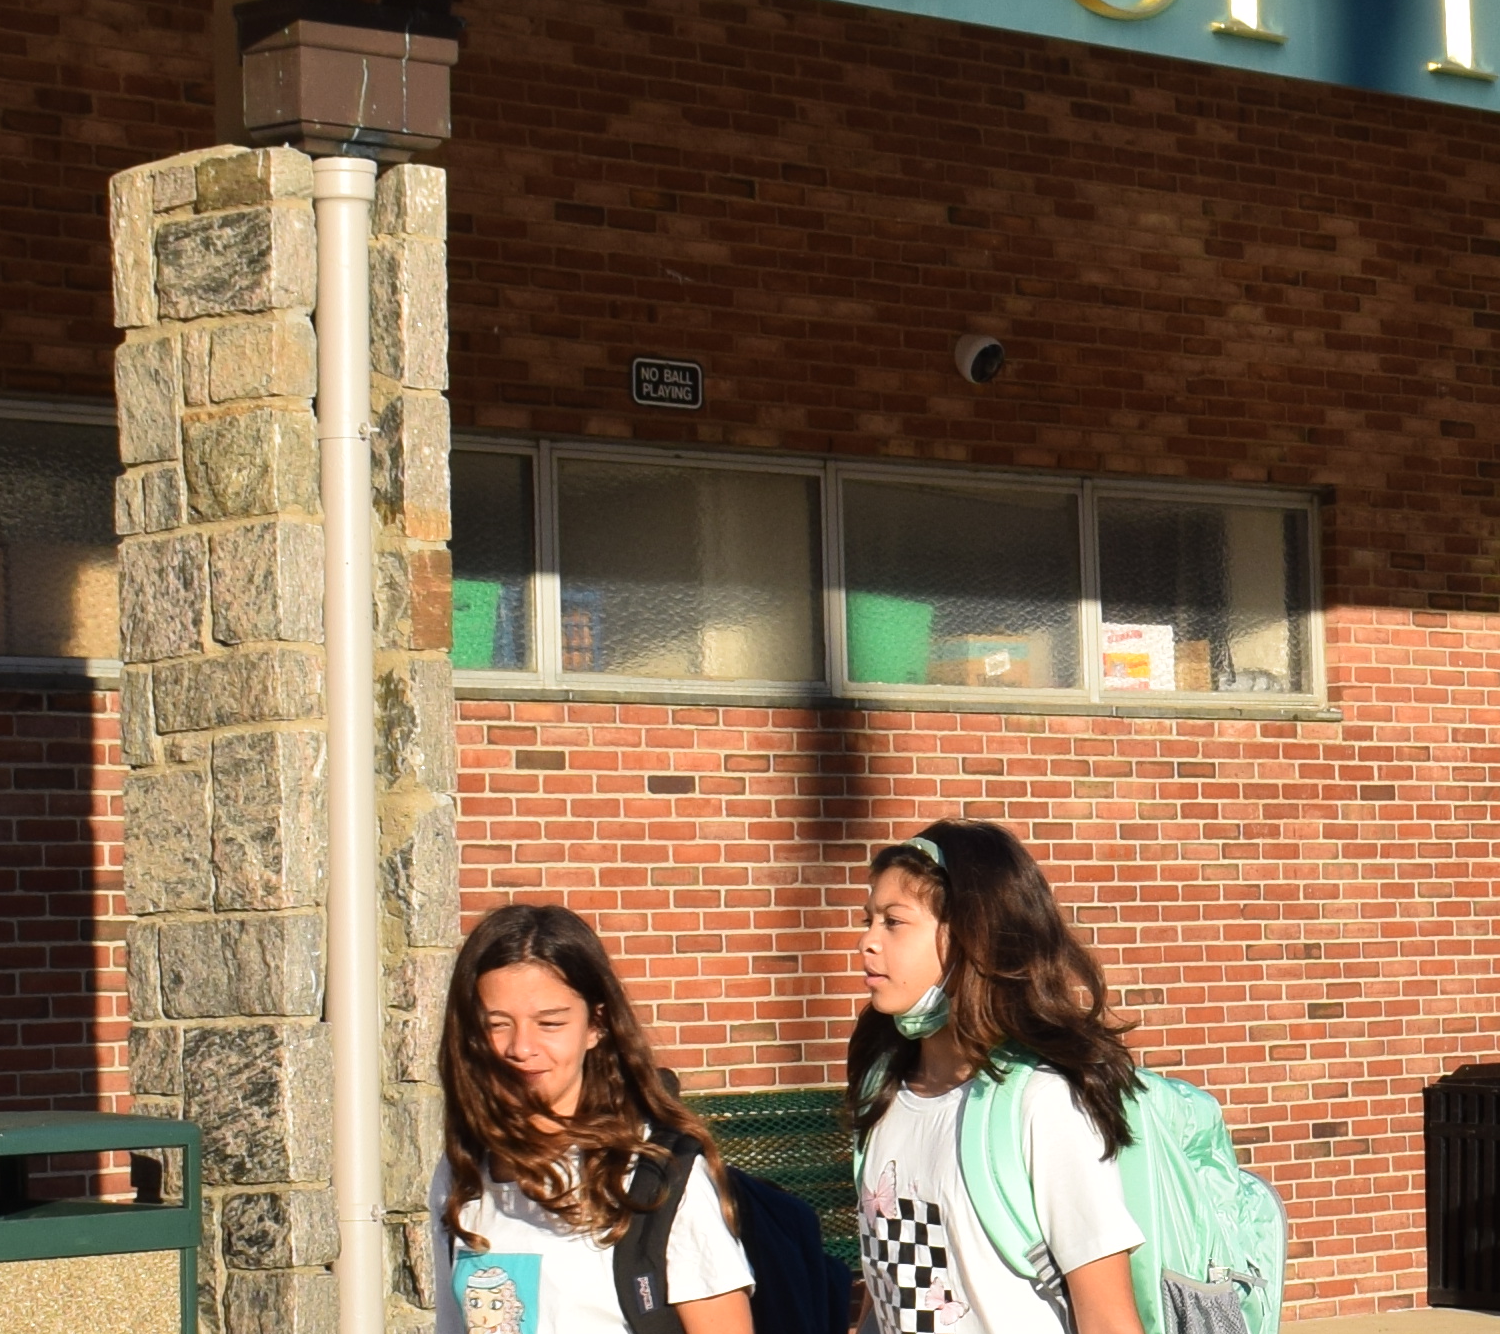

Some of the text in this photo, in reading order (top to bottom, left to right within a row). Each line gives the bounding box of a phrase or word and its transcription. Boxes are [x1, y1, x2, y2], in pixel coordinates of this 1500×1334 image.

[641, 367, 693, 385] NO BALL
[642, 382, 693, 400] PLAYING
